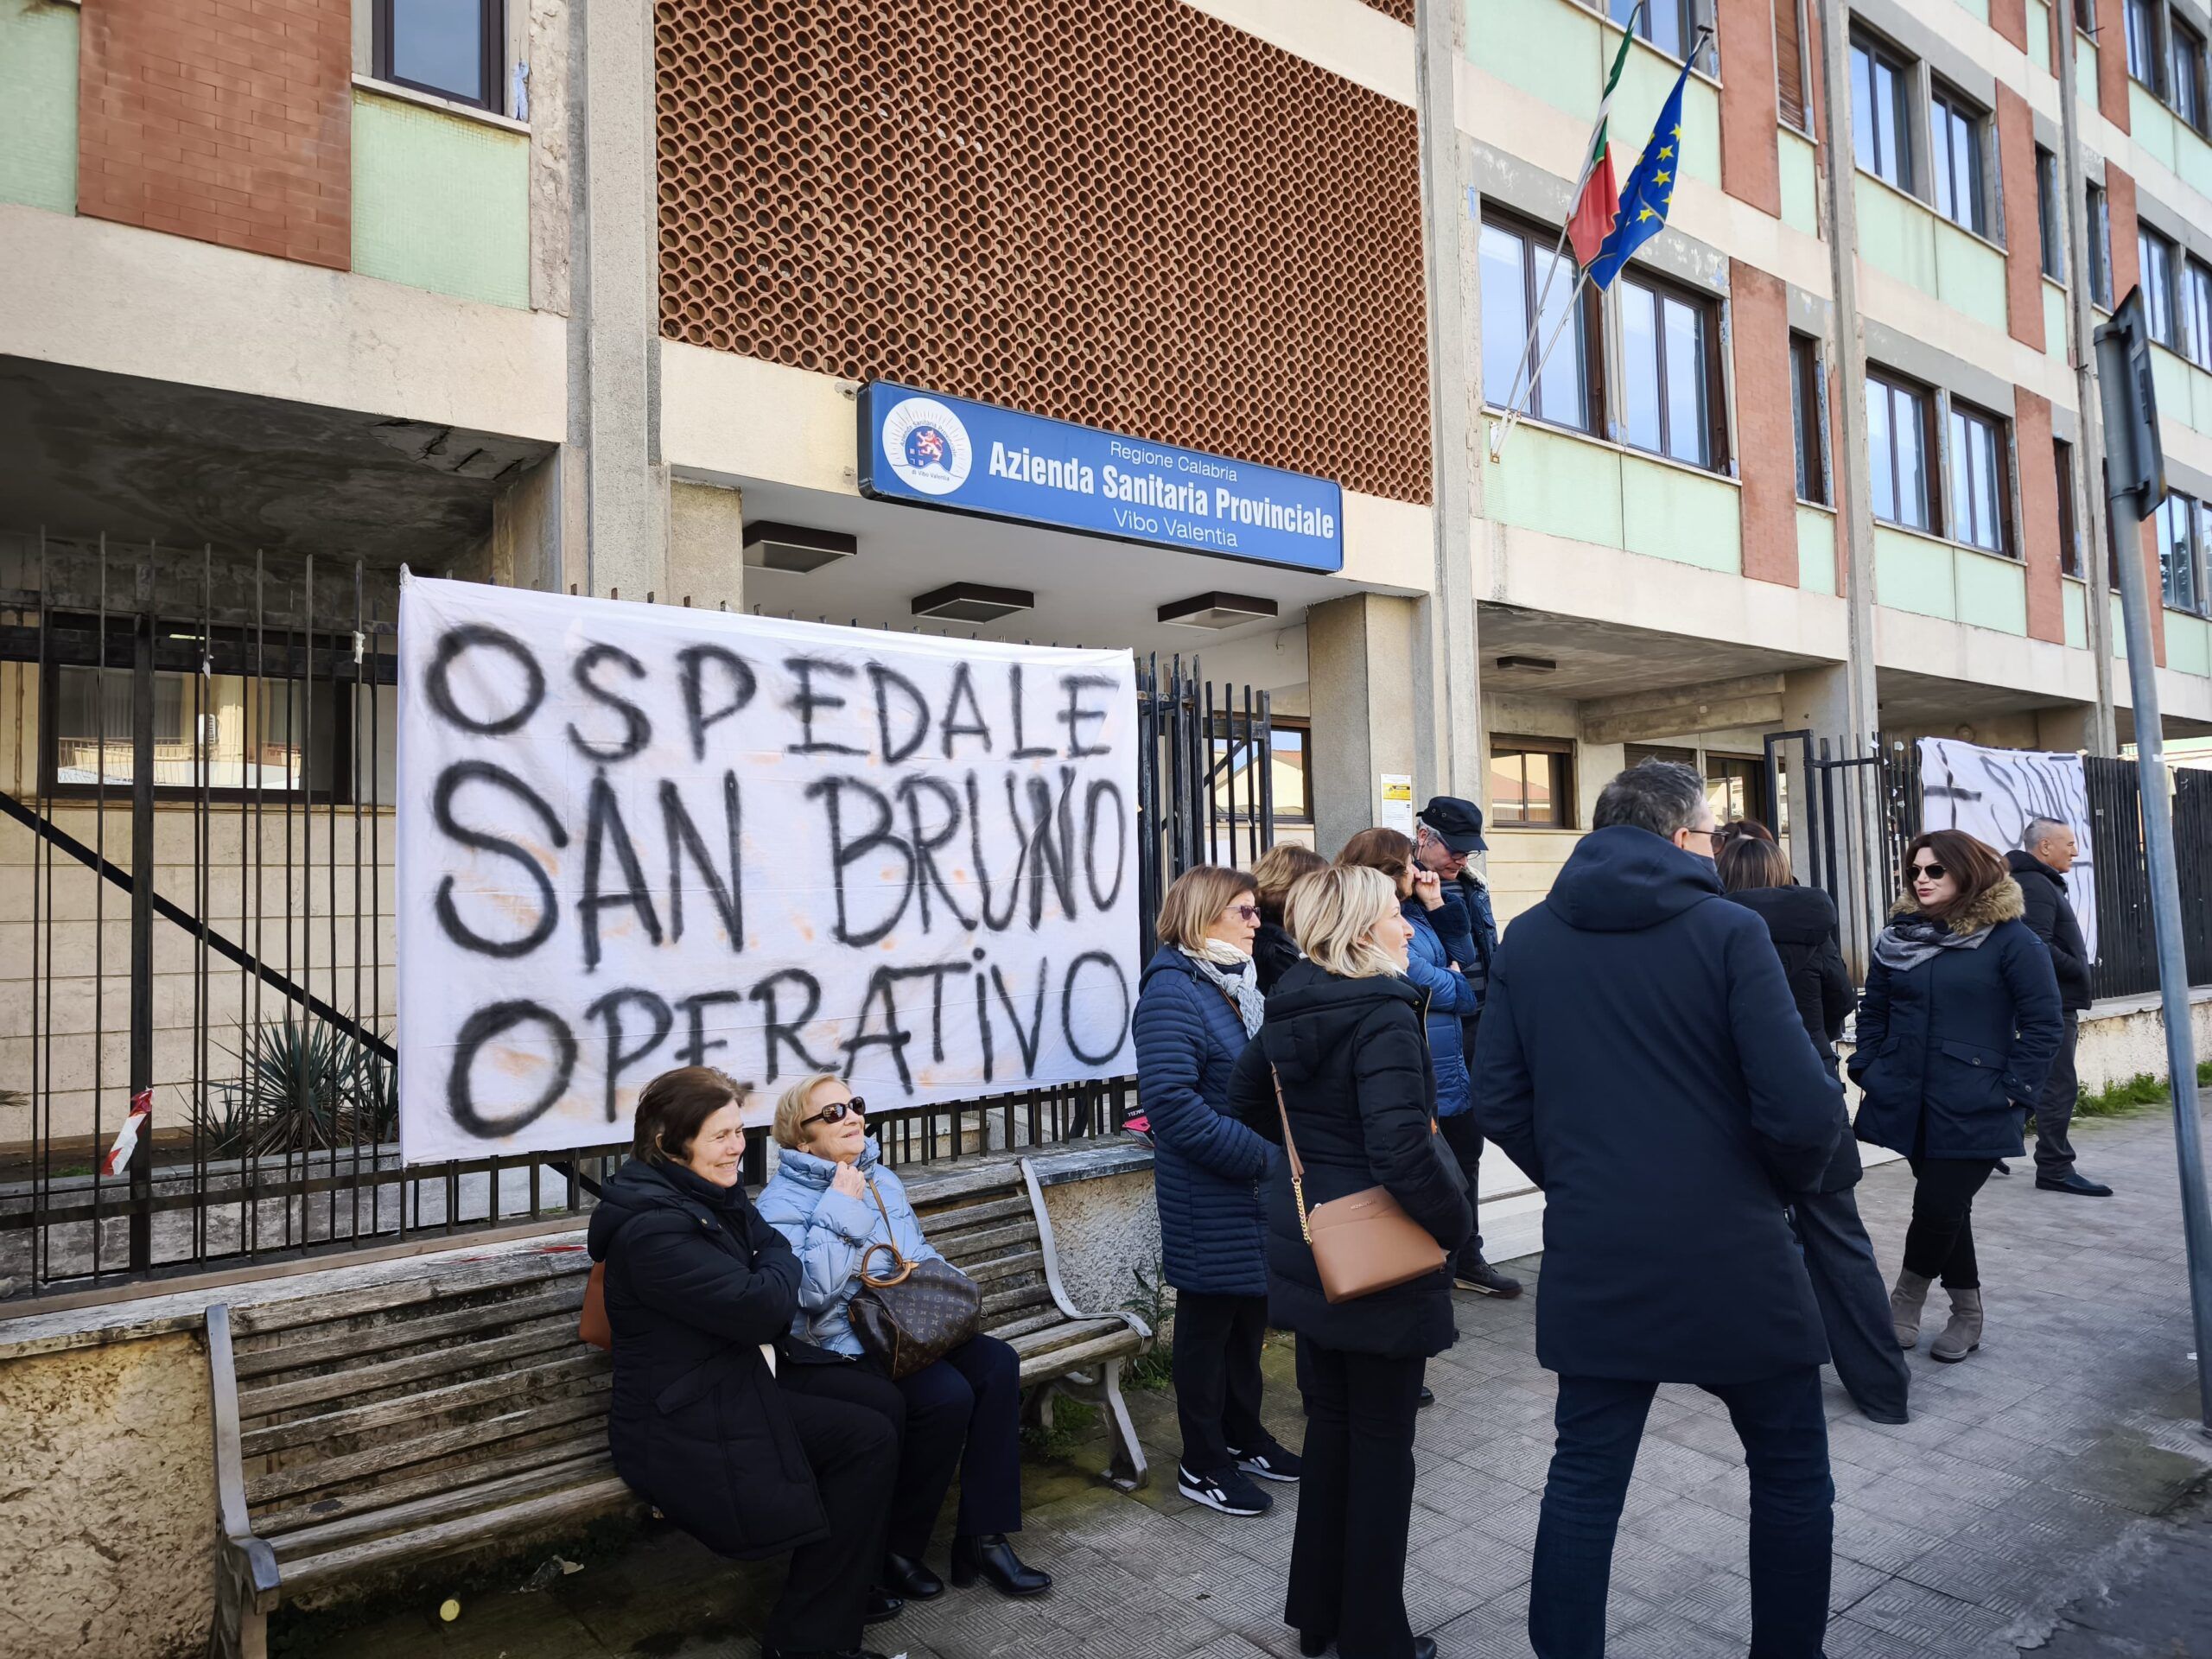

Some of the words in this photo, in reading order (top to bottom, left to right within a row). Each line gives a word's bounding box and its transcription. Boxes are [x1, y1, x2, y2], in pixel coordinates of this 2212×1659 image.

[988, 441, 1095, 495] Azienda
[1102, 464, 1209, 517] Sanitaria
[1216, 486, 1334, 539] Provinciale
[1110, 440, 1173, 468] Regione
[1178, 455, 1238, 482] Calabria
[1113, 507, 1159, 534] Vibo
[1163, 516, 1238, 548] Valentia
[425, 621, 1122, 766] OSPEDALE
[432, 759, 746, 973] SAN
[804, 763, 1126, 948] BRUNO
